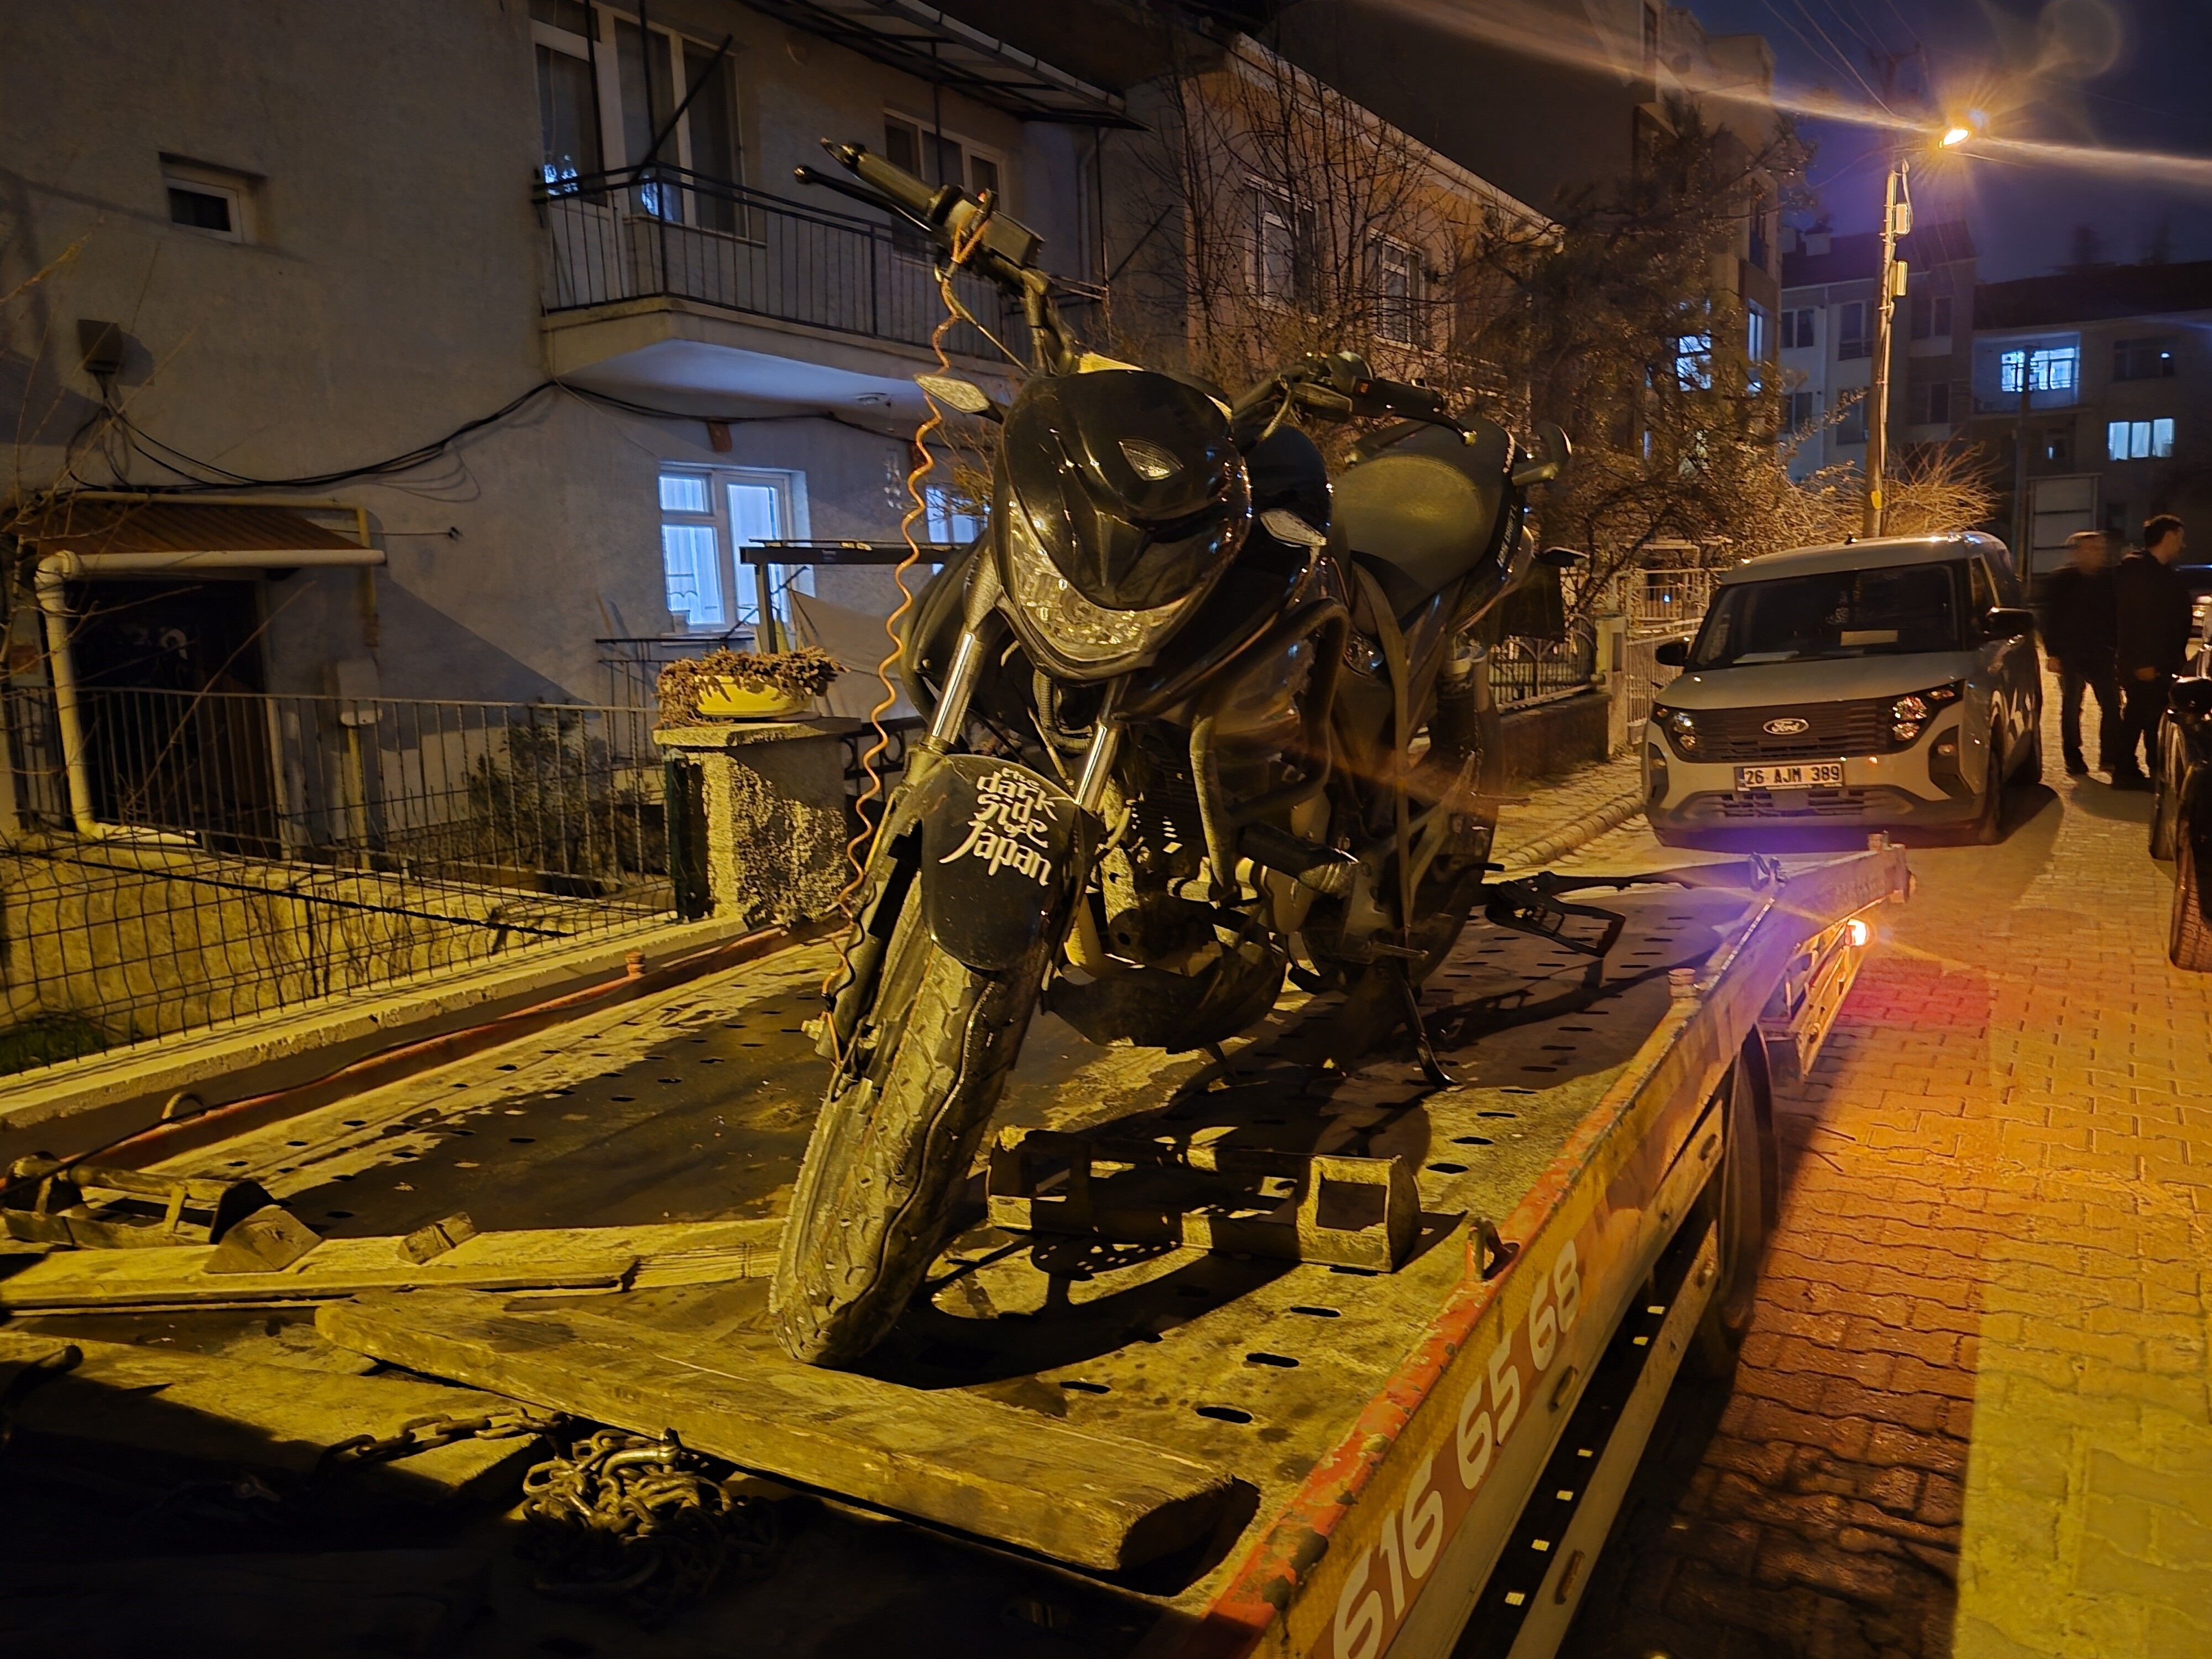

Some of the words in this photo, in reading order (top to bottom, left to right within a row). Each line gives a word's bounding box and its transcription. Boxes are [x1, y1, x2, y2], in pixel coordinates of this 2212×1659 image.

[1771, 721, 1800, 732] Ford
[1745, 770, 1764, 785] 26
[1773, 768, 1802, 783] AJM
[1811, 765, 1839, 781] 389
[977, 771, 1058, 821] dark
[1004, 823, 1027, 838] of
[938, 820, 1052, 886] Japan
[1333, 1452, 1443, 1659] 616
[1457, 1331, 1520, 1490] 65
[1528, 1240, 1580, 1371] 68
